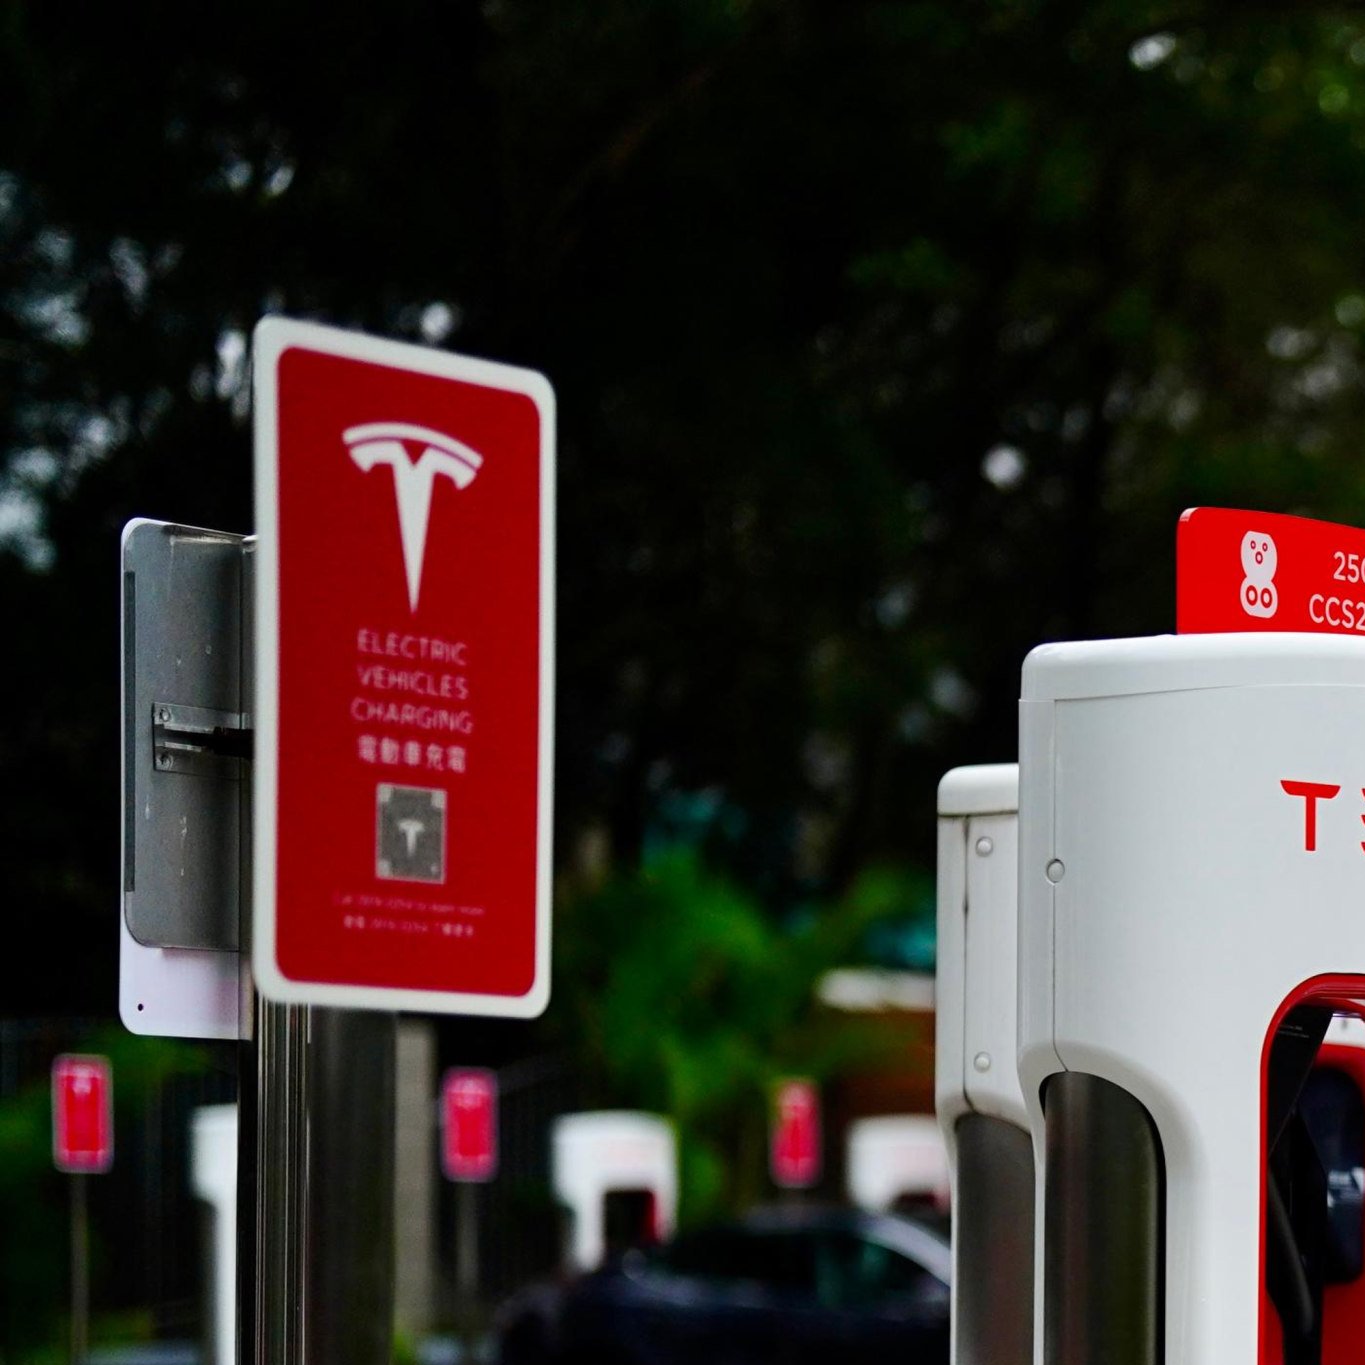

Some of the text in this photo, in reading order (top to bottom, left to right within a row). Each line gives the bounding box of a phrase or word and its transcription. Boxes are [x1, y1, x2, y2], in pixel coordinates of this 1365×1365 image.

[357, 628, 467, 666] ELECTRIC
[357, 665, 469, 700] VEHICLES
[351, 697, 473, 734] CHARGING
